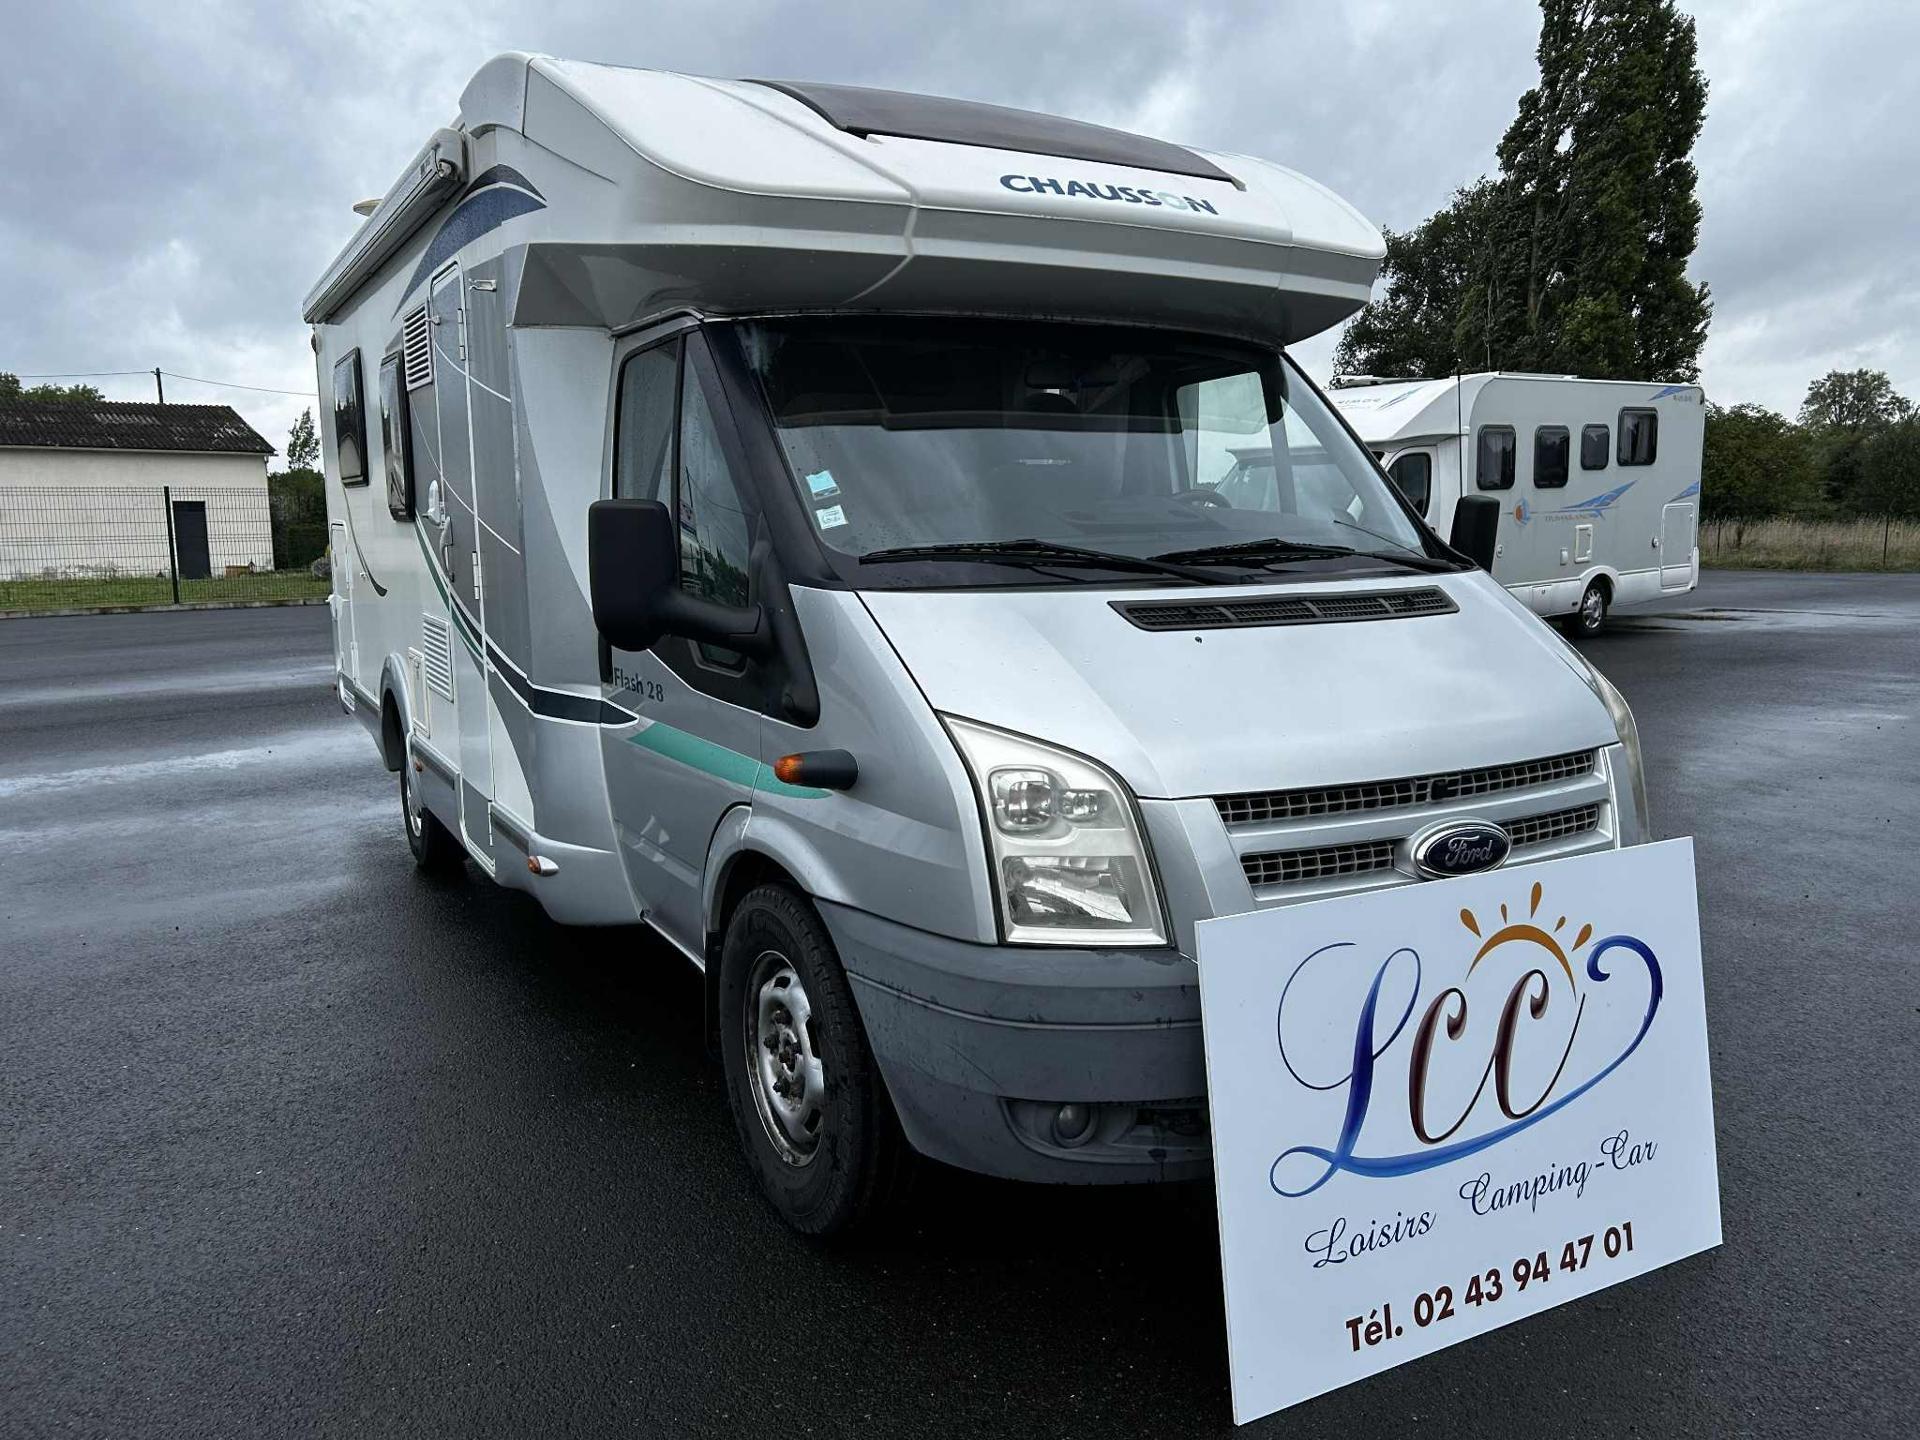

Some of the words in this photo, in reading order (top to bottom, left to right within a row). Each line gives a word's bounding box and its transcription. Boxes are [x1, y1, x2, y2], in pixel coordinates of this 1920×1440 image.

[1000, 174, 1219, 216] CHAUSSON
[613, 666, 644, 696] Flash
[646, 680, 664, 702] 28
[1445, 835, 1494, 867] Ford
[1270, 942, 1588, 1198] LCC
[1304, 1211, 1437, 1268] Loisirs
[1459, 1129, 1658, 1215] Camping-Car
[1346, 1303, 1403, 1352] Tél.
[1413, 1285, 1455, 1327] 02
[1464, 1268, 1503, 1307] 43
[1512, 1251, 1551, 1292] 94
[1559, 1234, 1595, 1272] 47
[1603, 1221, 1634, 1259] 01
